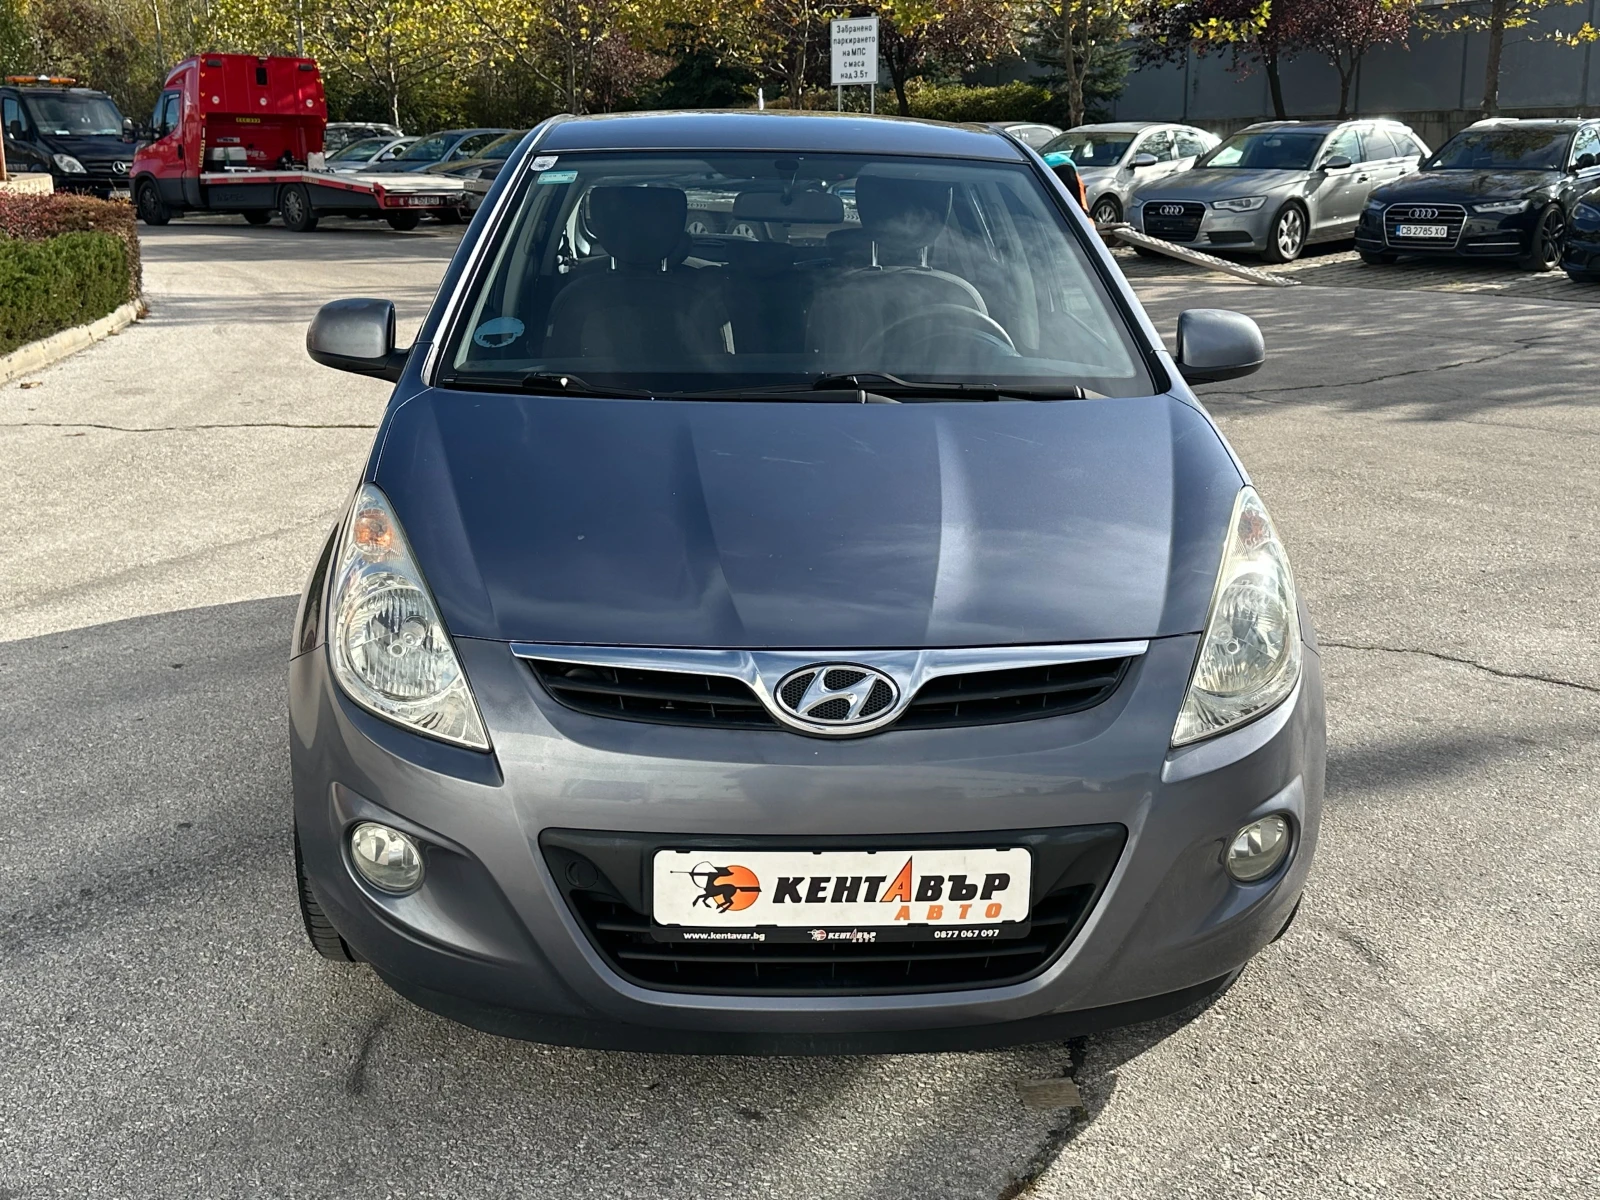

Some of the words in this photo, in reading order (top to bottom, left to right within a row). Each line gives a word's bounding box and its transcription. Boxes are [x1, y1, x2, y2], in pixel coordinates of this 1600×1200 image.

[836, 25, 873, 34] Забранено
[833, 36, 876, 46] паркирането
[851, 47, 866, 56] МПС
[840, 72, 853, 80] над
[1412, 226, 1433, 236] 2785
[772, 855, 1011, 904] КЕНТАВЪР
[894, 902, 1002, 921] АВТО
[683, 931, 766, 941] www.kentavar.bg
[933, 930, 960, 939] 0877
[960, 929, 980, 938] 067
[980, 929, 1000, 937] 097
